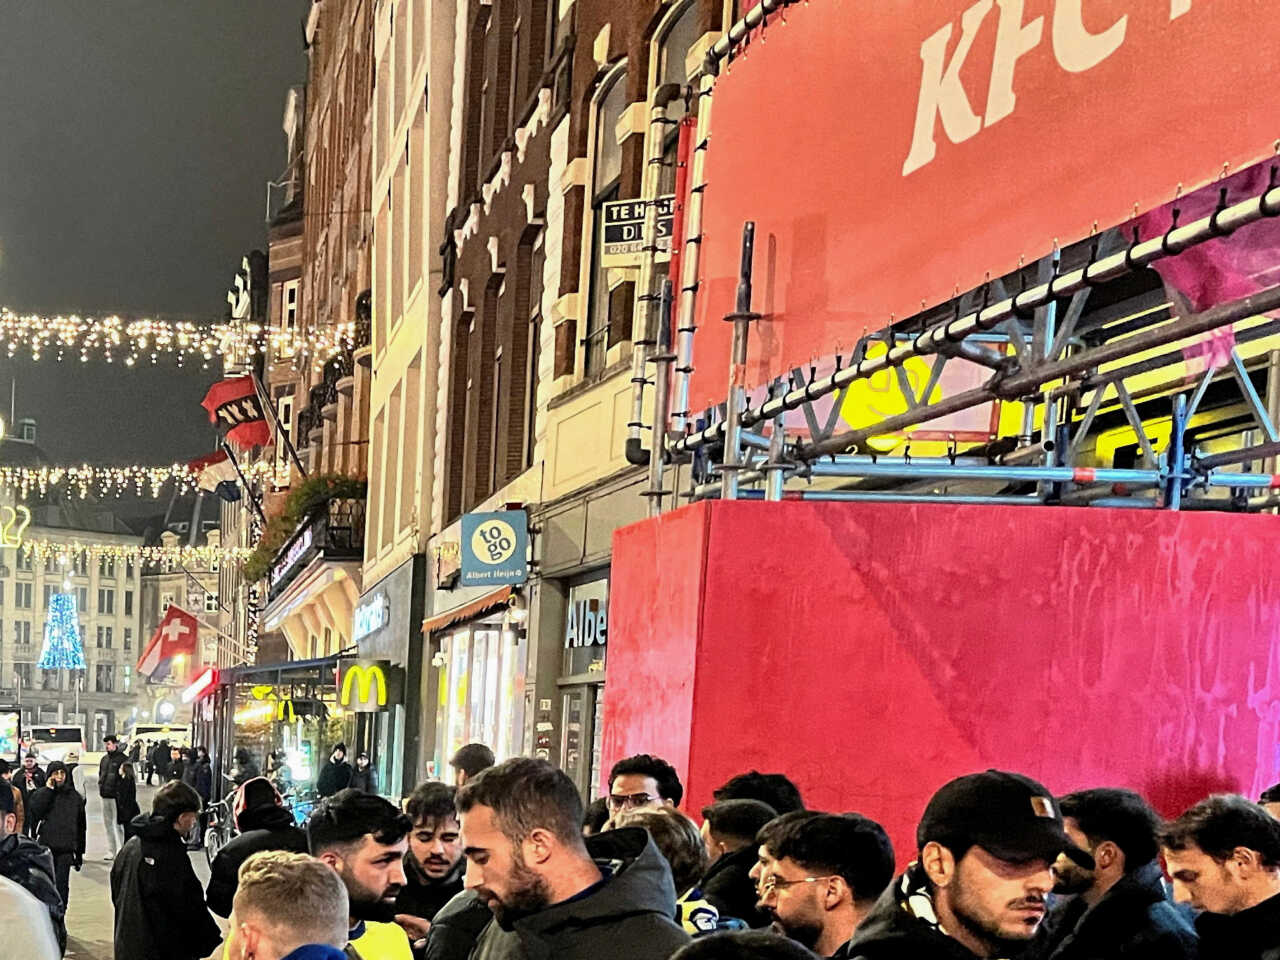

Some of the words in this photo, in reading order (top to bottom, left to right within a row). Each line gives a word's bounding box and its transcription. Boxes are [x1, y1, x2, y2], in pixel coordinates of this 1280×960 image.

[611, 206, 630, 219] TE
[479, 526, 502, 544] to
[487, 537, 511, 561] go
[565, 599, 606, 648] Albe
